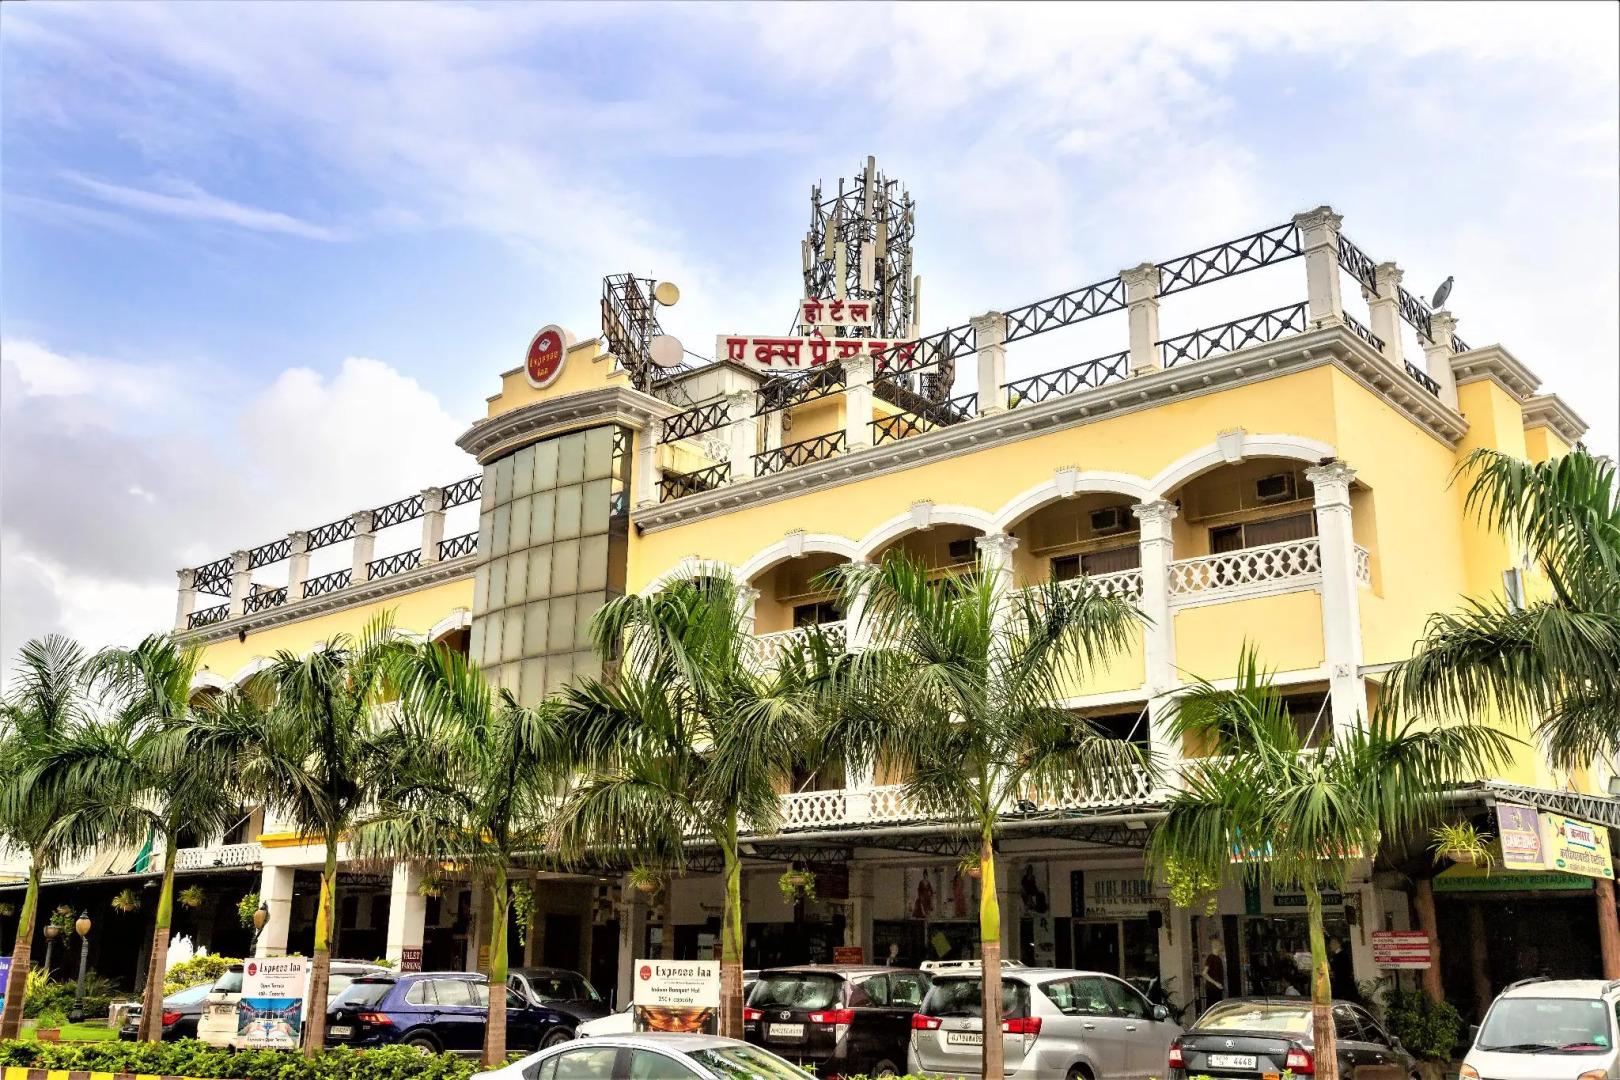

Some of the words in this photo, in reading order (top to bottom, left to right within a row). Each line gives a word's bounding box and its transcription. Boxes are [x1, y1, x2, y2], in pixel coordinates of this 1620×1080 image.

[403, 951, 420, 960] VALET
[259, 963, 288, 973] Express
[290, 962, 301, 972] Inn
[656, 966, 694, 978] Express
[697, 966, 712, 977] Inn
